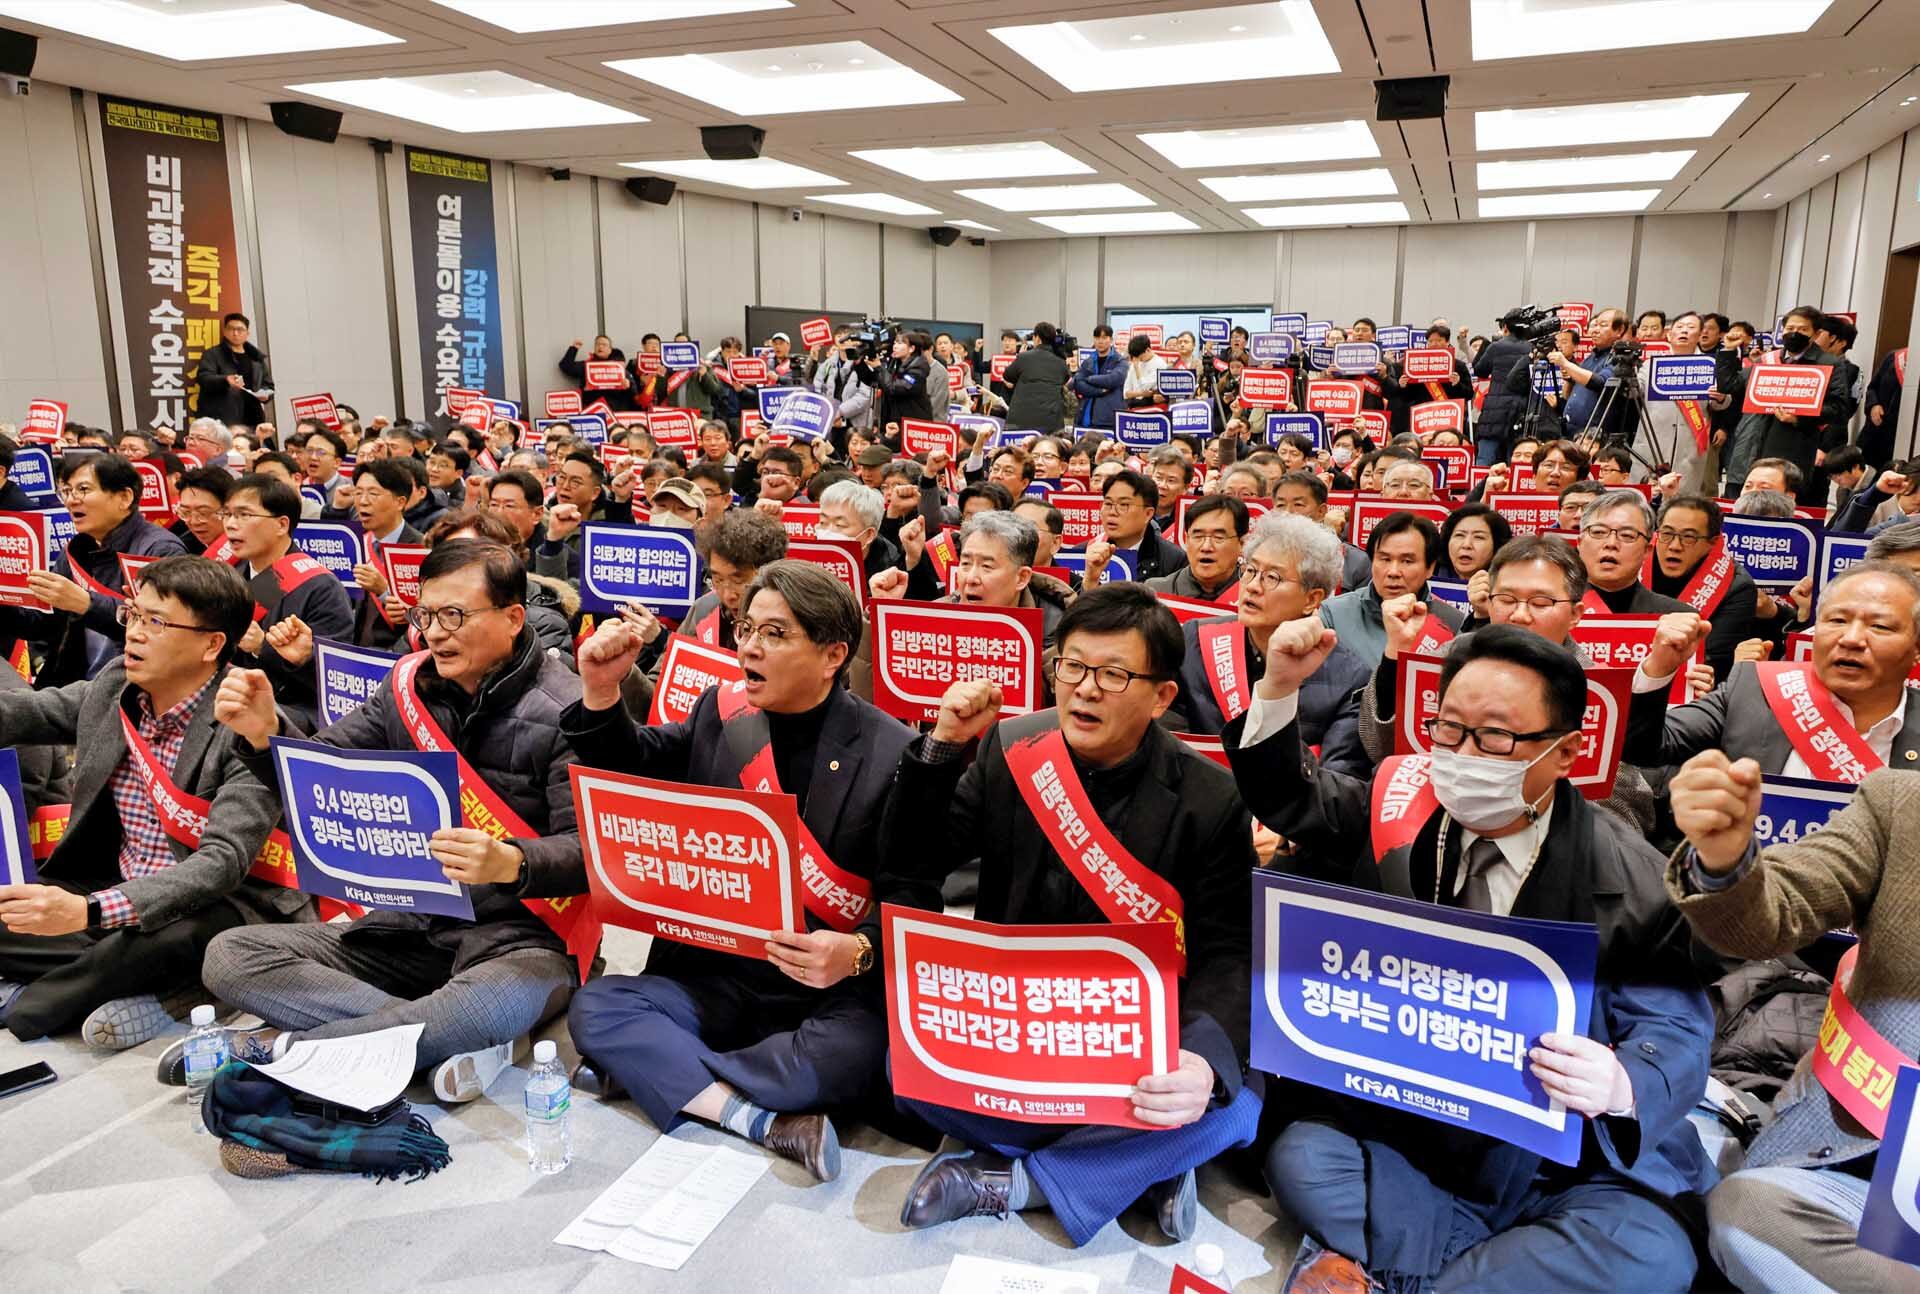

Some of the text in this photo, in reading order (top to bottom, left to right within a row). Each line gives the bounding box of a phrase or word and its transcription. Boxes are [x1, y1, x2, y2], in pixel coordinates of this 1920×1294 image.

[147, 154, 187, 432] 비과학적 수요조사
[186, 244, 222, 313] 즉각
[463, 268, 488, 325] 강력
[462, 330, 487, 391] 규탄
[1059, 508, 1089, 522] 방적인
[1061, 523, 1089, 537] 민건강
[0, 535, 29, 555] 책추진
[308, 539, 345, 554] 의정합의
[592, 544, 687, 568] 의료계와 합의없는
[1740, 536, 1791, 553] 의정합의
[1748, 553, 1798, 571] 이행하라
[592, 564, 687, 588] 의대증원 결사반대
[1687, 574, 1722, 612] 정책추
[891, 629, 1021, 662] 일방적인 정책추진
[1211, 634, 1237, 694] 의대정원
[1579, 642, 1610, 664] 학적
[327, 668, 366, 699] 의료계와
[891, 655, 953, 683] 국민건강
[1775, 669, 1867, 784] 일방적인 정책추
[312, 783, 412, 825] 9.4 의정합의
[310, 815, 433, 861] 정부는 이행하라
[599, 812, 771, 870] 비과학적 수요조사
[1031, 760, 1162, 924] 일방적인 정책추진
[1754, 814, 1799, 844] 9.4
[624, 851, 751, 904] 즉각 폐기하라
[799, 852, 866, 921] 확대추진
[914, 960, 1142, 1015] 일방적인 정책추진
[1321, 940, 1509, 1021] 9.4 의정합의
[917, 1002, 1144, 1060] 국민건강 위협한다
[1301, 977, 1530, 1072] 정부는 이행하라
[1024, 1100, 1086, 1113] 대한의사협회
[1402, 1088, 1470, 1118] 대한의사협회
